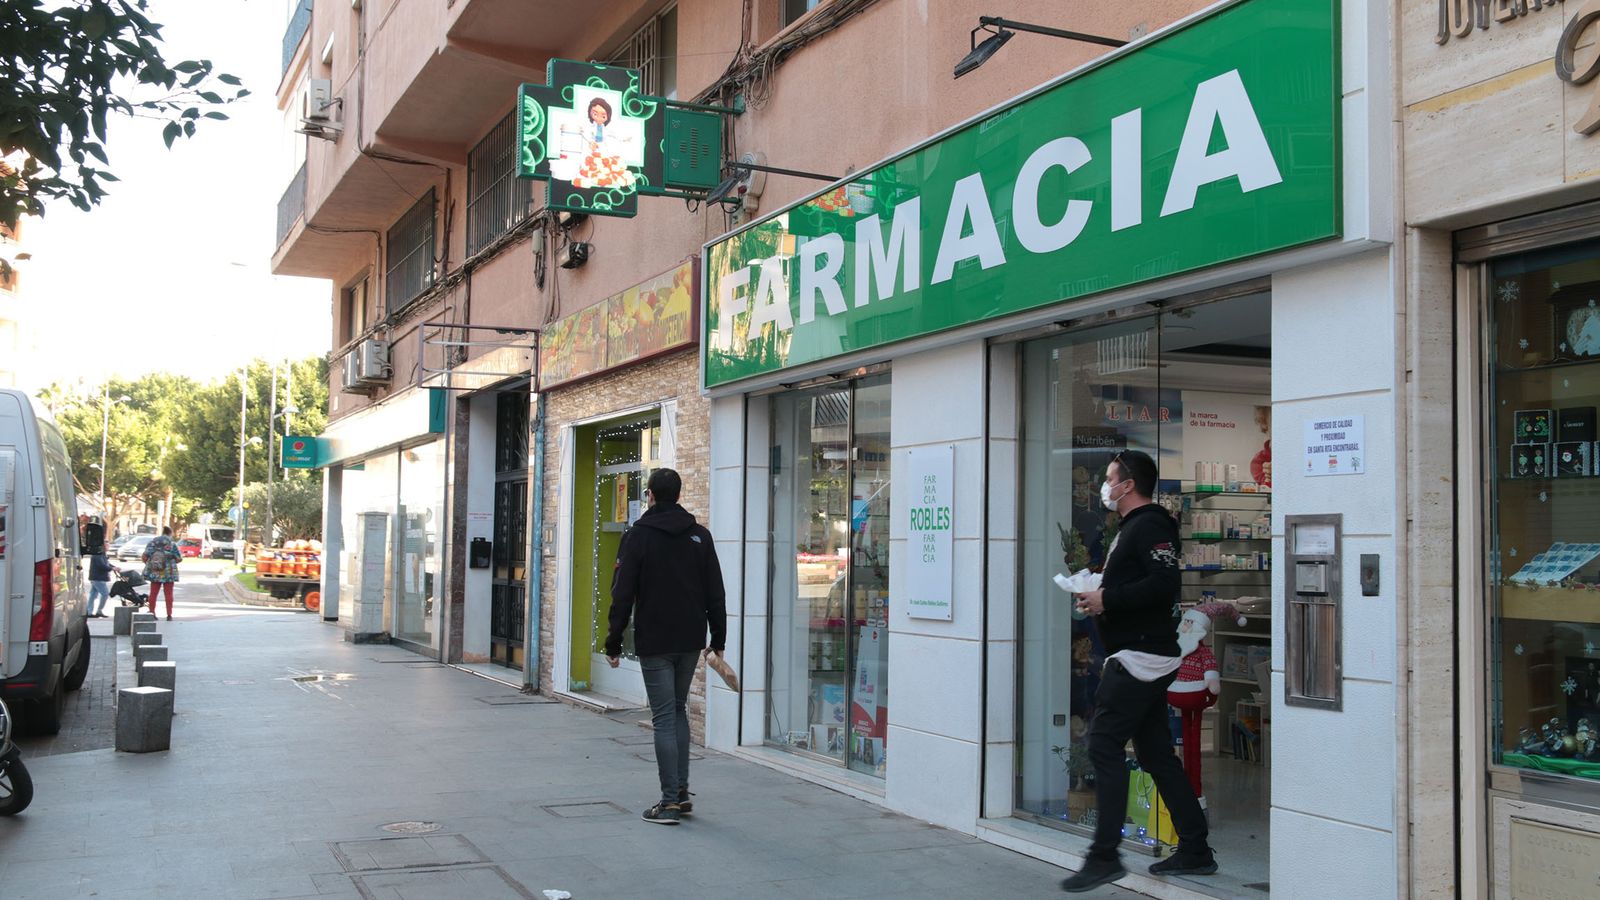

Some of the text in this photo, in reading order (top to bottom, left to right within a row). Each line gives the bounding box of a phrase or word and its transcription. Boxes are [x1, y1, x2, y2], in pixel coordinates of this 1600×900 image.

[719, 68, 1283, 352] FARMACIA
[1207, 420, 1235, 428] farmacia
[1333, 420, 1337, 429] DE
[1338, 420, 1352, 428] CALIDAD
[1076, 434, 1115, 446] Nutribén
[1313, 445, 1324, 453] SANTA
[924, 475, 936, 484] FAR
[923, 485, 936, 494] MA
[923, 495, 936, 504] CIA
[911, 506, 950, 531] ROBLES
[923, 534, 935, 543] FAR
[923, 544, 935, 553] MA
[923, 554, 935, 563] CIA
